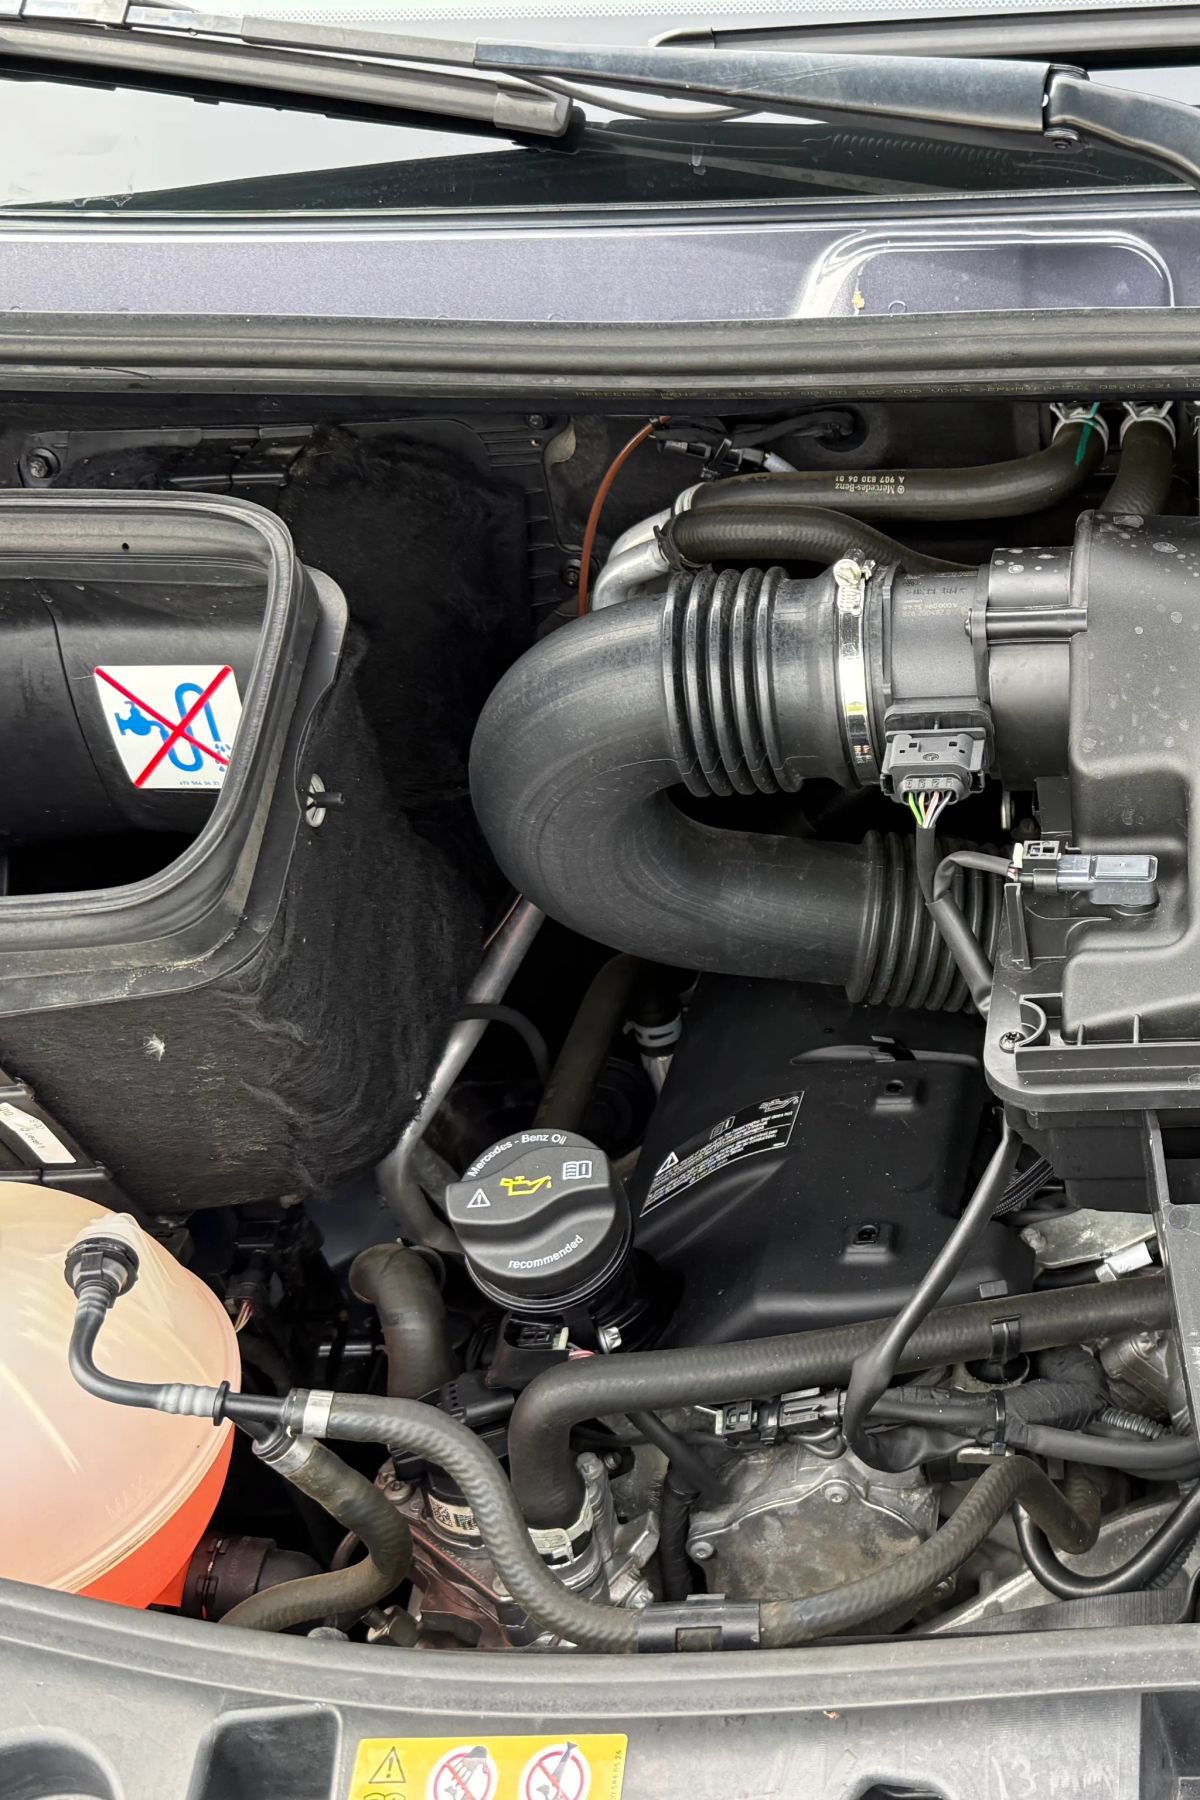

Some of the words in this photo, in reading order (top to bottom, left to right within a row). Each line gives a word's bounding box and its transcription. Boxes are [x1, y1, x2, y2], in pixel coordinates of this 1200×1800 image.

[861, 475, 877, 483] 830
[880, 475, 896, 483] 907
[899, 475, 906, 483] A
[834, 482, 896, 495] Mercedes-Benz
[467, 1139, 513, 1178] Mercedes
[521, 1134, 549, 1144] Benz
[551, 1133, 568, 1145] Oil
[508, 1234, 585, 1269] recommended
